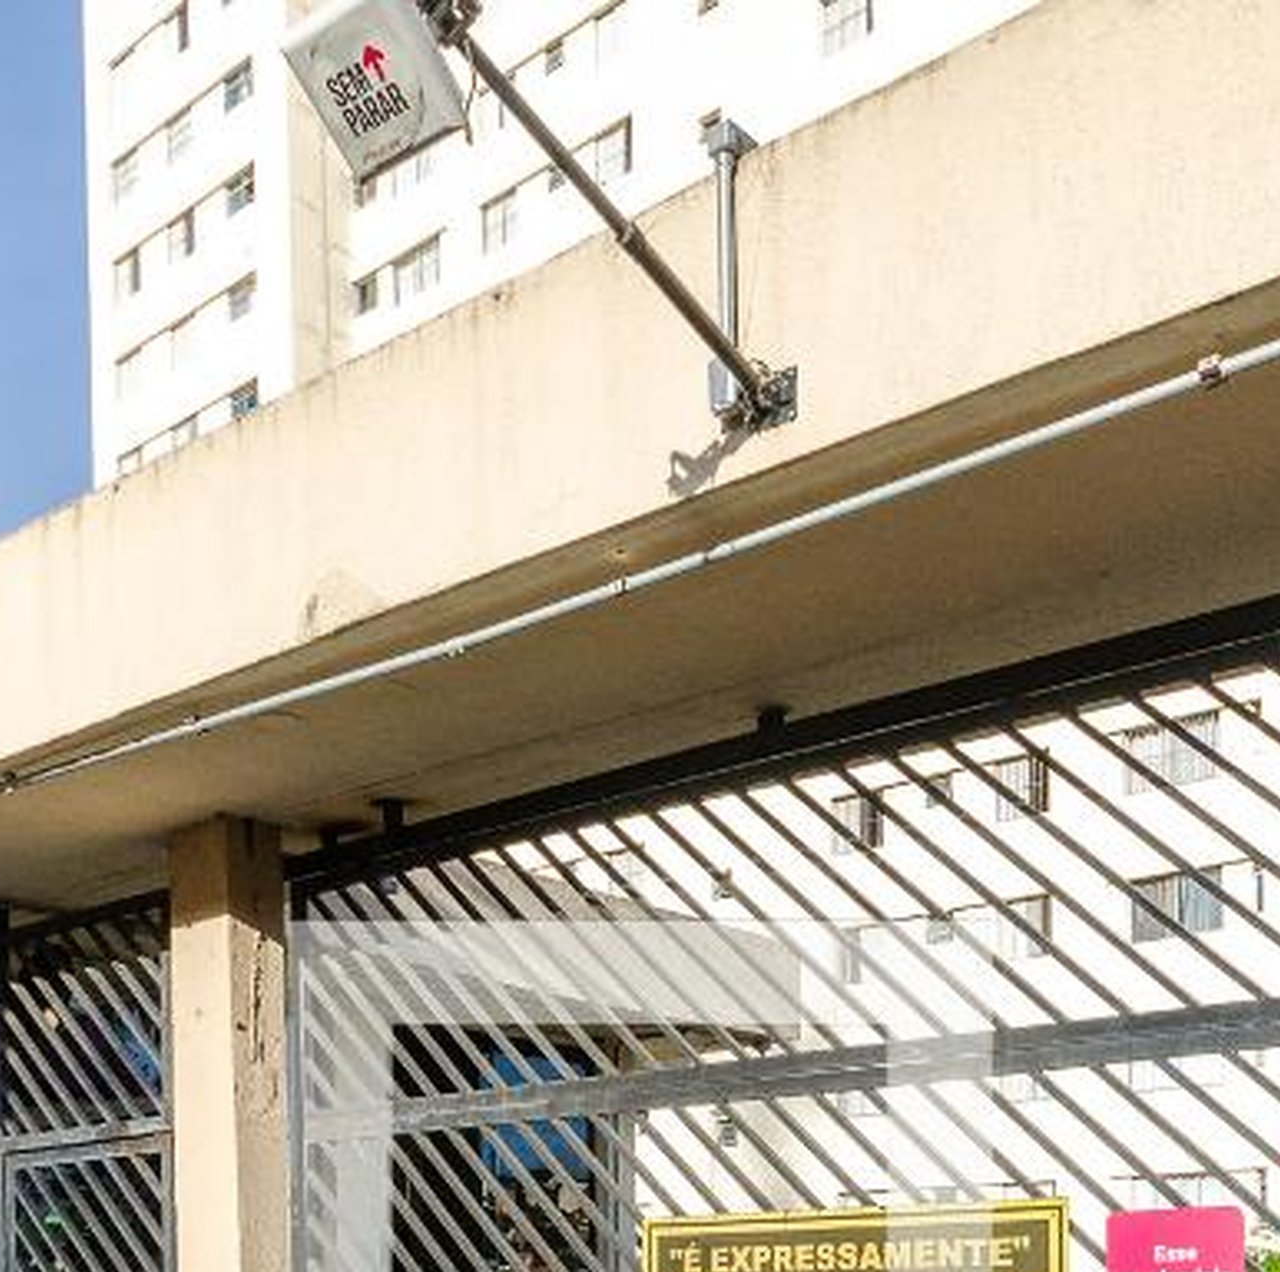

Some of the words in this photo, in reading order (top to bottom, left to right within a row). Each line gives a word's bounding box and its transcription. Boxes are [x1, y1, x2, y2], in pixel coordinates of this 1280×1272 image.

[325, 62, 374, 108] SEM
[341, 82, 412, 138] PARAR
[1153, 1244, 1199, 1263] Esse
